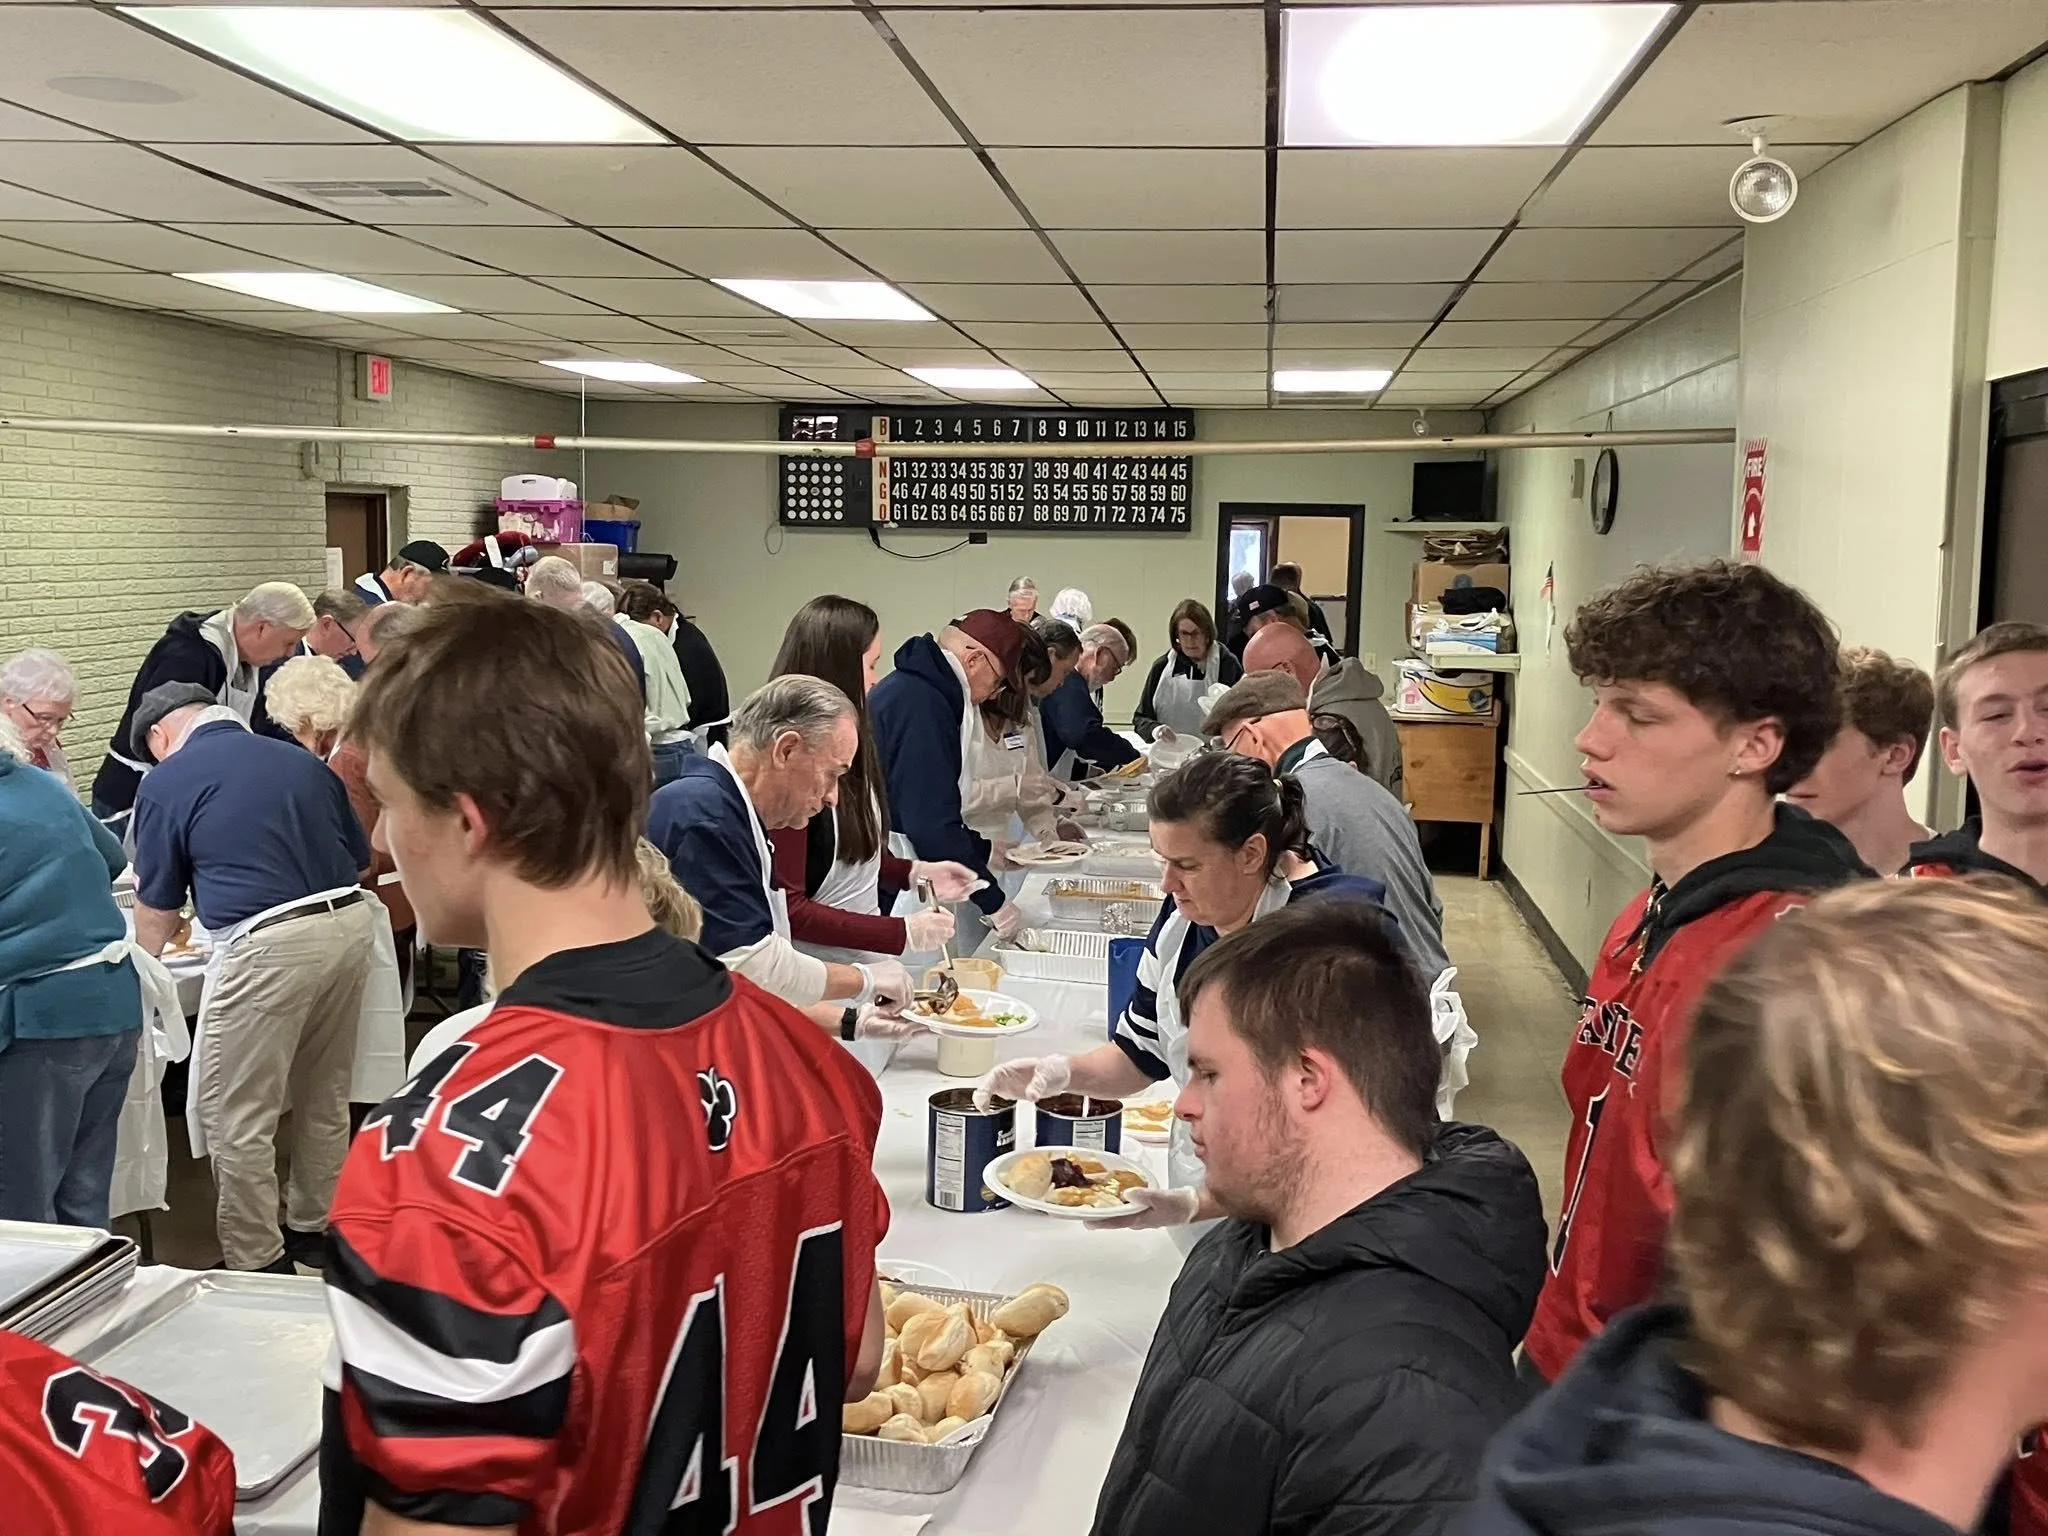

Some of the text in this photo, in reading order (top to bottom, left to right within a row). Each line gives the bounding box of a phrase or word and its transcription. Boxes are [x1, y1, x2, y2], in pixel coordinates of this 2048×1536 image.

[896, 419, 1187, 437] 1 2 3 4 5 6 7 8 9 10 11 12 13 14 15
[893, 462, 1187, 480] 31 32 33 34 35 36 37 38 39 40 41 42 43 44 45
[892, 483, 1186, 501] 46 47 48 49 50 51 52 53 54 55 56 57 58 59 60
[893, 505, 1186, 522] 61 62 63 64 65 66 67 68 69 70 71 72 73 74 75
[361, 1041, 564, 1197] 44
[615, 1219, 844, 1536] 44
